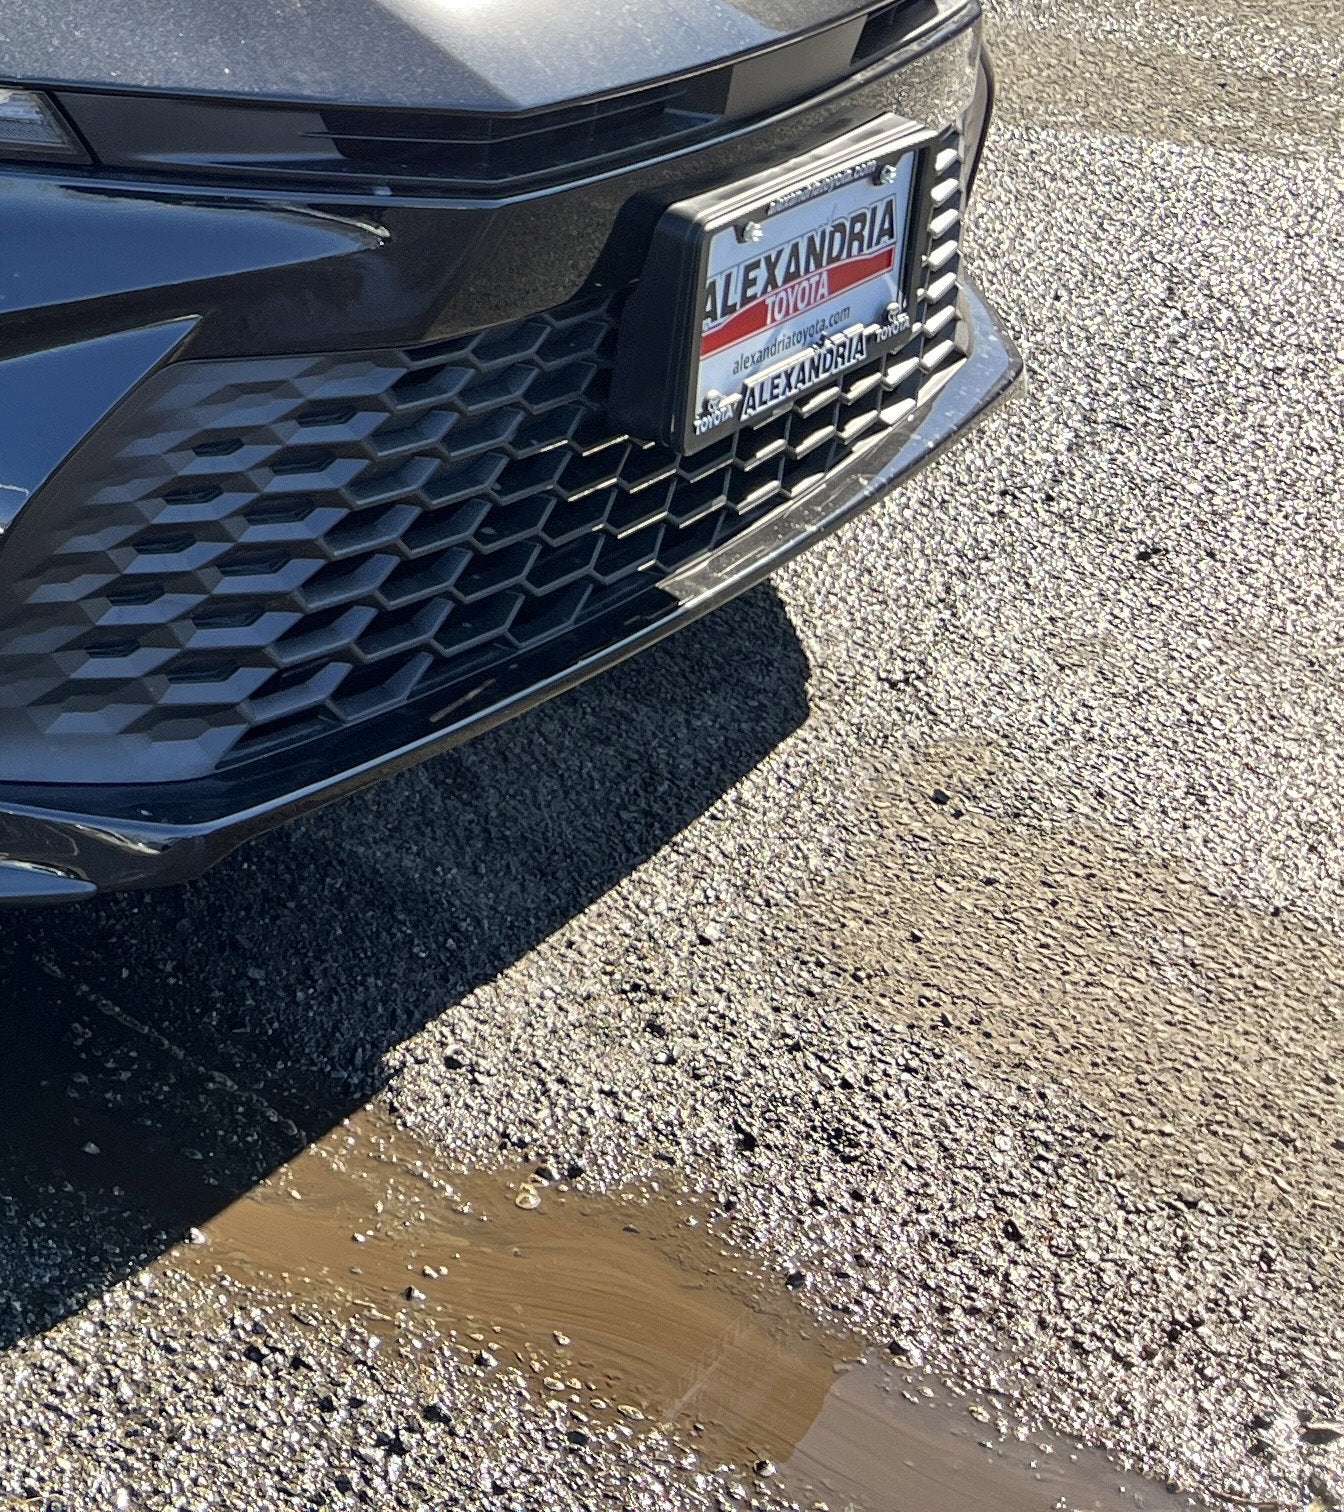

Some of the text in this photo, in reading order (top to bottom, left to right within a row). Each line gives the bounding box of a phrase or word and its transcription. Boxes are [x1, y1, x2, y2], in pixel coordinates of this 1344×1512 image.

[703, 198, 895, 322] ALEXANDRIA
[765, 270, 829, 325] TOYOTA
[875, 313, 911, 343] TOYOTA
[732, 306, 851, 375] alexandriatoyota.com
[742, 334, 867, 420] ALEXANDRIA
[693, 403, 733, 435] TOYOTA
